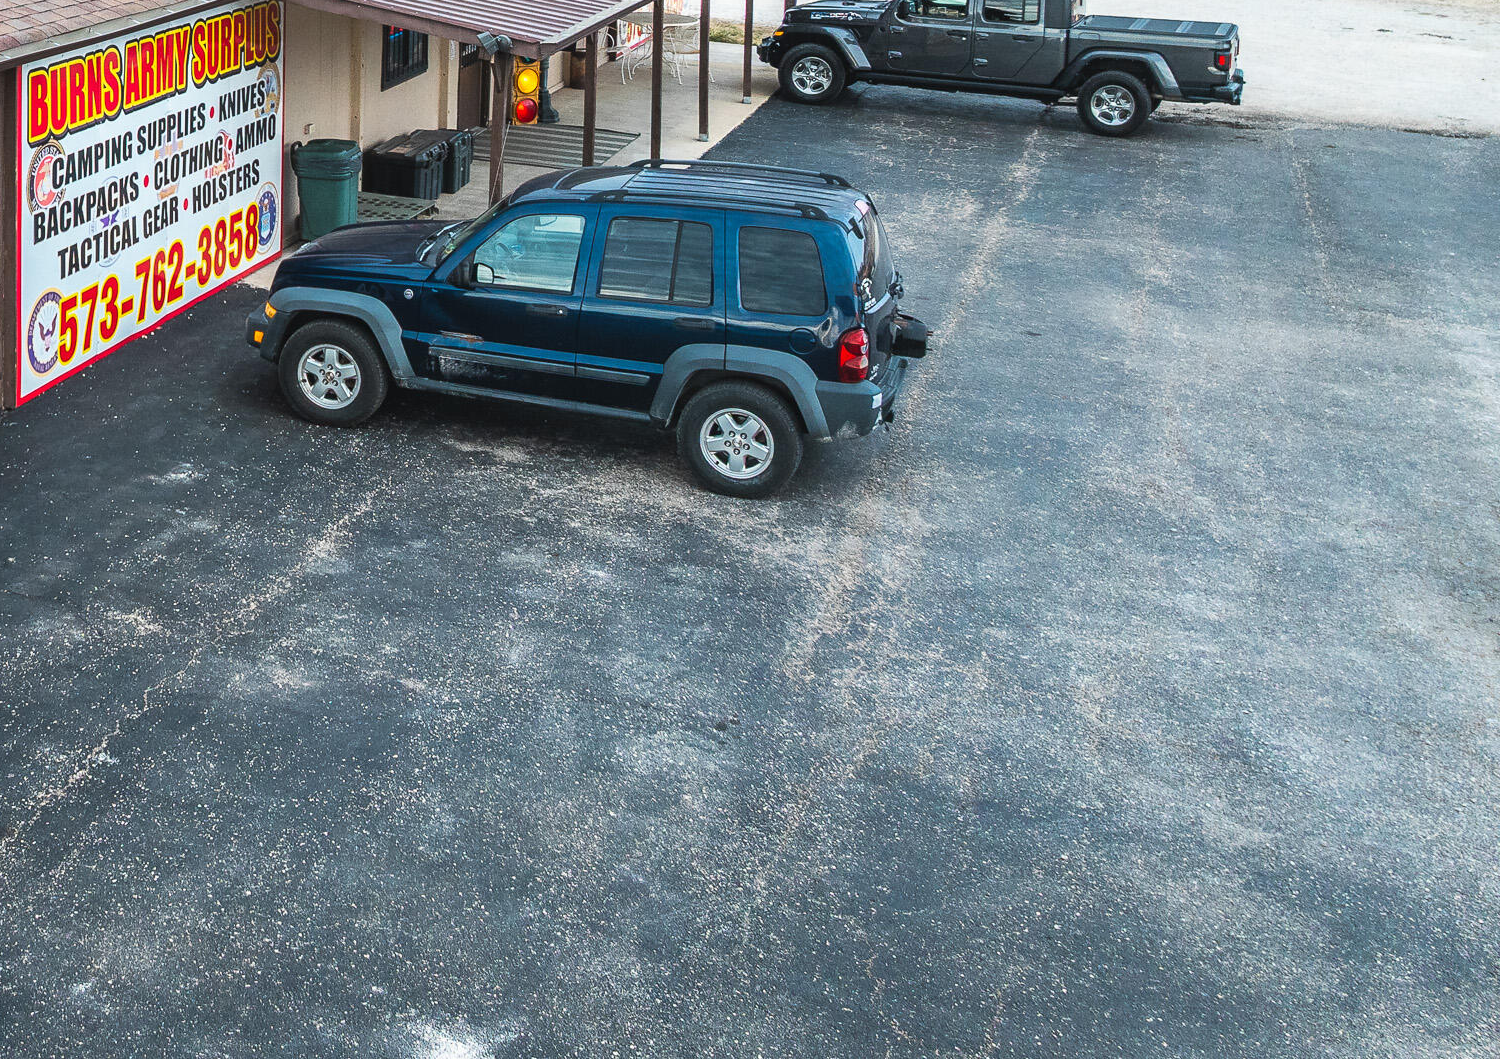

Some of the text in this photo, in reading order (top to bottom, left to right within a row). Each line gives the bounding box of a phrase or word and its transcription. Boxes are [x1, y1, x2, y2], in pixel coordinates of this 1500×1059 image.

[28, 0, 280, 148] BURNS ARMY SURPLUS
[51, 79, 266, 190] CAMPING SUPPLIES KNIVES
[33, 113, 277, 246] BACKPACKS CLOTHING AMMO
[56, 158, 260, 280] TACTICAL GEAR HOLSTERS
[58, 202, 260, 366] 573-762-3858
